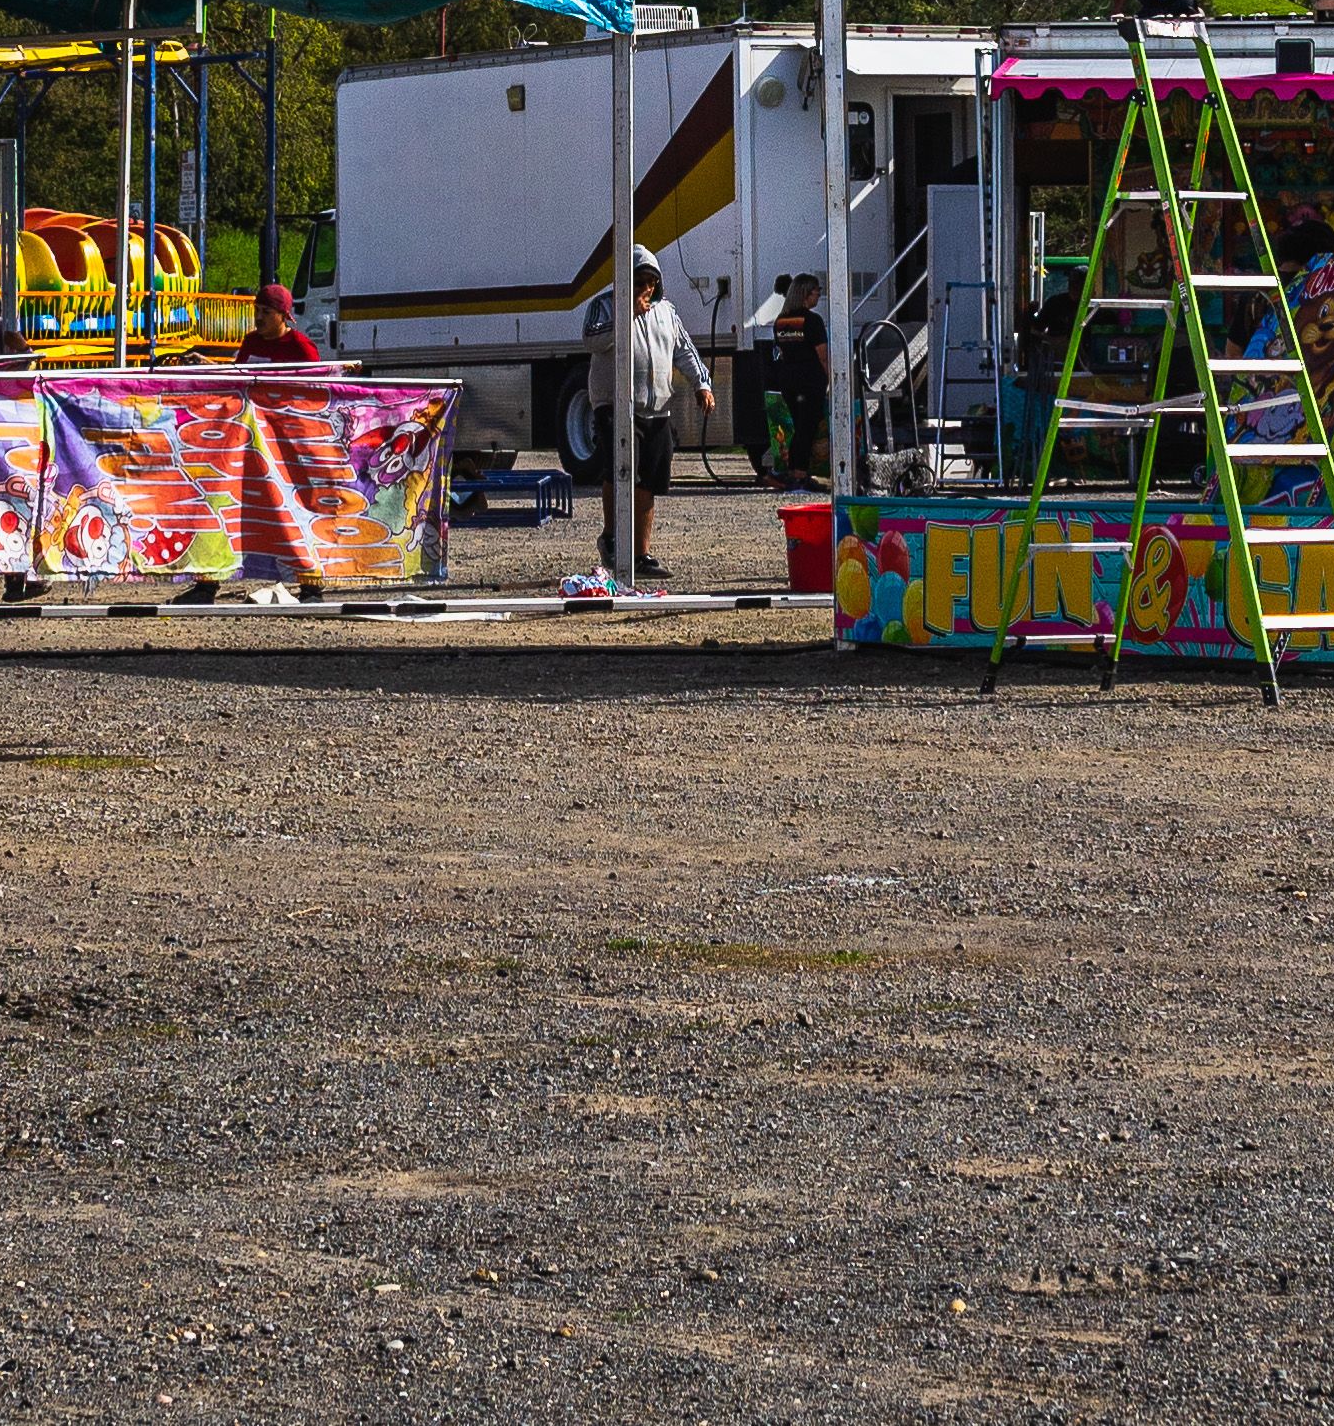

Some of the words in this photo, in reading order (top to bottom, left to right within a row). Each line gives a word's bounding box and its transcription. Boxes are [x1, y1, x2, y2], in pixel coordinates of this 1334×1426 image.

[82, 428, 222, 532] FUN!
[160, 392, 316, 572] POPPIN'
[249, 384, 404, 577] BALLOON
[924, 518, 1093, 635] FUN
[1130, 535, 1173, 635] &
